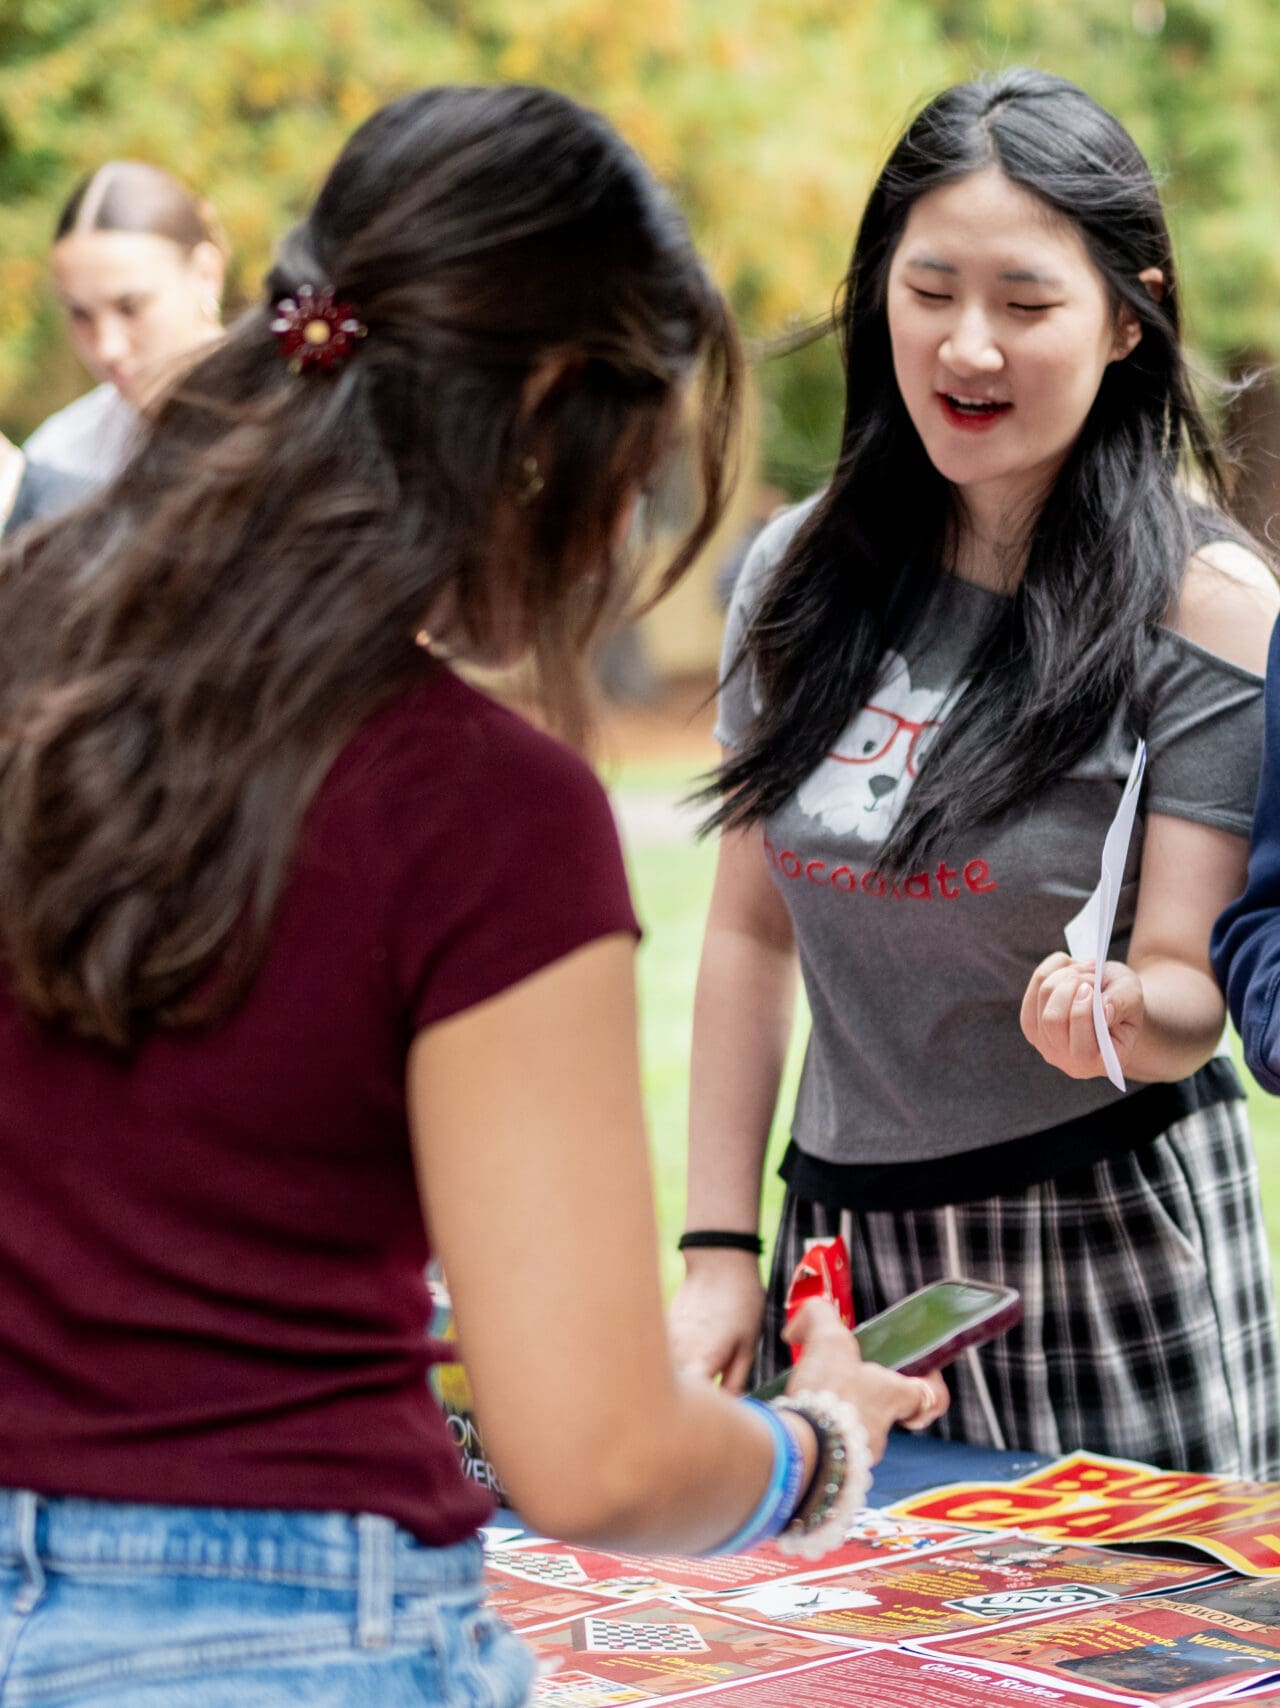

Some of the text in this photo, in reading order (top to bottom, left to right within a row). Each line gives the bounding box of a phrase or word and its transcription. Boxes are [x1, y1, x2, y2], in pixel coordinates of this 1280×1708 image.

[763, 836, 998, 901] ocooate
[980, 1594, 1087, 1605] UNO
[920, 1662, 1066, 1699] Game Rules
